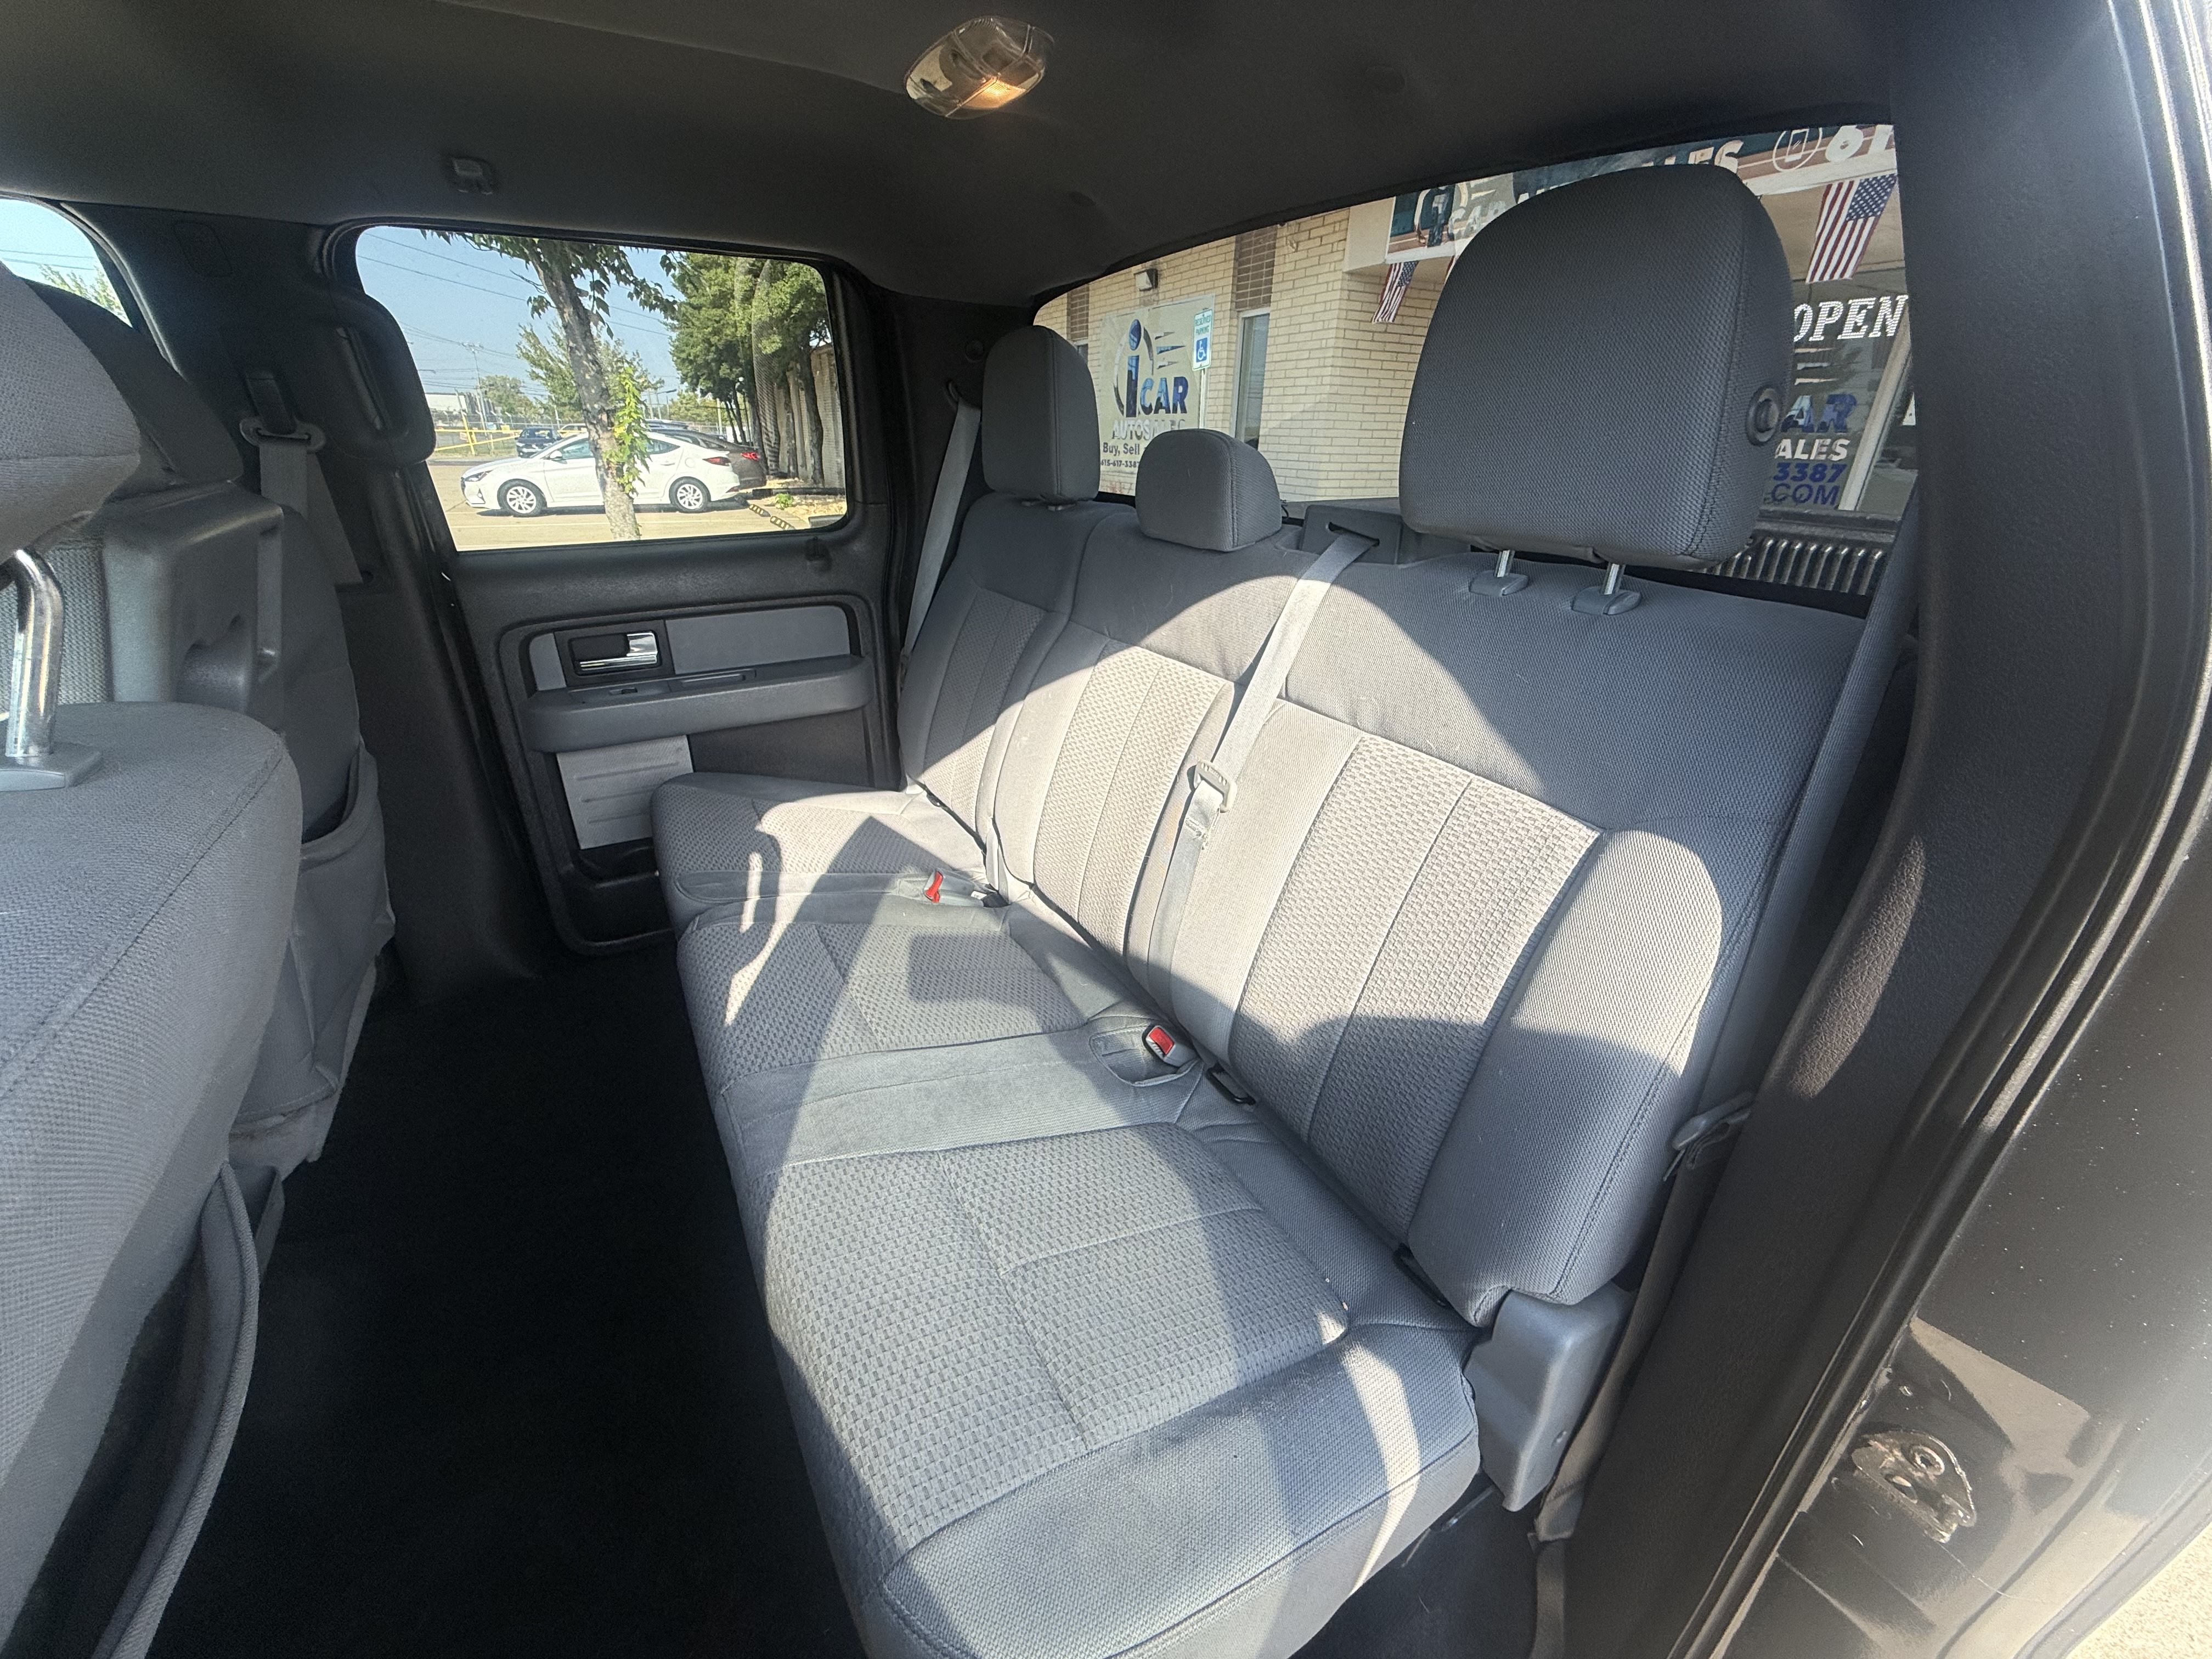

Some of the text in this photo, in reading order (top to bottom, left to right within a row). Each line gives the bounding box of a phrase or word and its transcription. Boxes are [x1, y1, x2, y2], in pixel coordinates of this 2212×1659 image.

[1794, 294, 1909, 342] OPEN
[1780, 392, 1858, 434] AR
[1103, 442, 1140, 456] Buy, Sell
[1774, 438, 1851, 461] ALES
